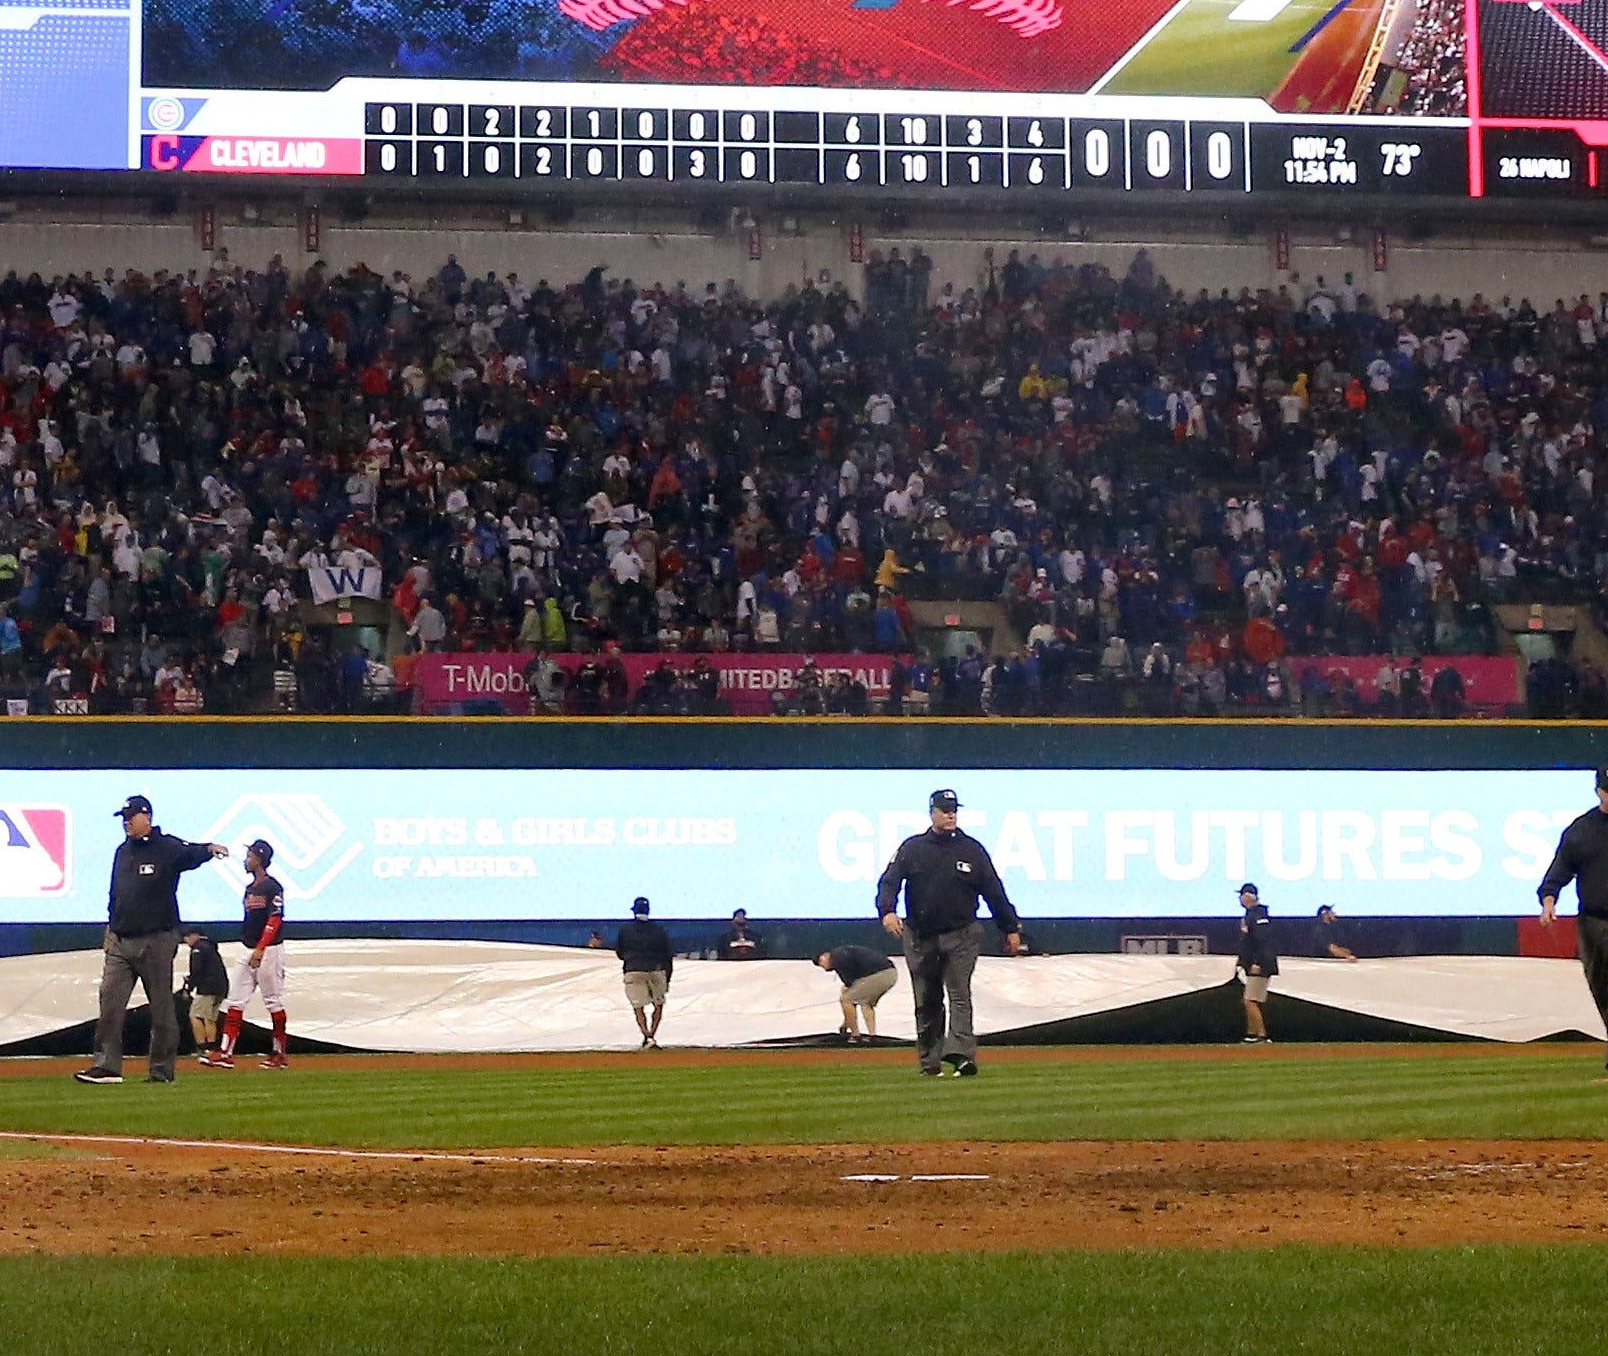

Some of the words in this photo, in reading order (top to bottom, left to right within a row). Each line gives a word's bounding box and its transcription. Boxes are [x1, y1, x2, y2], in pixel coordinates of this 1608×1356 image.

[382, 107, 395, 132] 0
[434, 108, 447, 133] 0
[486, 109, 499, 135] 2
[537, 110, 550, 136] 2
[589, 111, 599, 137] 1
[639, 112, 653, 138] 0
[690, 113, 704, 139] 0
[741, 114, 754, 140] 0
[846, 117, 859, 142] 6
[902, 118, 926, 144] 10
[968, 119, 981, 145] 3
[1028, 121, 1043, 146] 4
[210, 139, 326, 169] CLEVELAND
[382, 144, 395, 170] 0
[434, 146, 444, 171] 1
[485, 146, 499, 172] 0
[537, 147, 550, 173] 2
[588, 149, 601, 174] 0
[639, 150, 653, 175] 0
[691, 151, 703, 176] 3
[741, 152, 755, 177] 0
[847, 154, 859, 179] 6
[902, 155, 926, 181] 10
[969, 157, 979, 182] 1
[1029, 158, 1042, 183] 6
[1086, 130, 1108, 175] 0
[1148, 131, 1169, 177] 0
[1209, 133, 1230, 178] 0
[325, 568, 365, 594] W
[442, 665, 530, 692] T-Mob
[373, 817, 469, 846] BOYS
[475, 817, 505, 846] &
[511, 817, 617, 846] GIRLS
[623, 817, 738, 846] CLUBS
[817, 808, 1089, 883] GAT
[1104, 809, 1484, 882] FUTURES
[373, 856, 414, 878] OF
[415, 856, 538, 878] AMERICA
